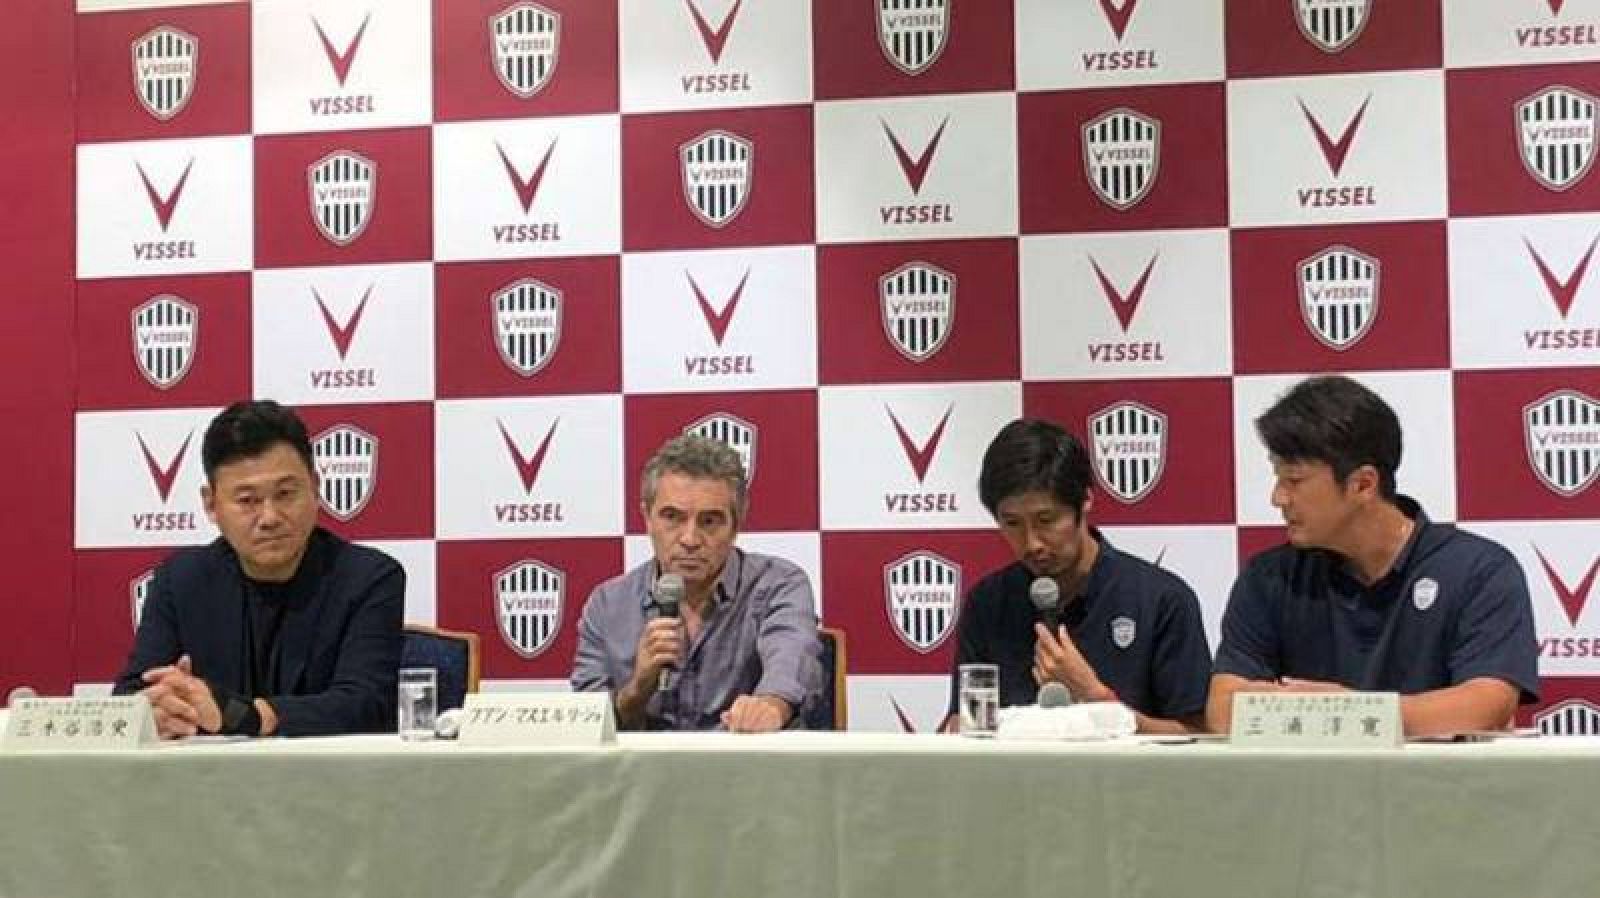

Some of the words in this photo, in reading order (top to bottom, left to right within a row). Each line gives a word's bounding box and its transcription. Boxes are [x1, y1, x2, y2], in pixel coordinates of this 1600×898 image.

[1516, 26, 1596, 46] VISSEL
[1082, 50, 1158, 70] VISSEL
[682, 74, 750, 92] VISSEL
[310, 96, 374, 114] VISSEL
[1298, 186, 1374, 206] VISSEL
[880, 204, 952, 224] VISSEL
[494, 224, 560, 242] VISSEL
[134, 240, 194, 260] VISSEL
[1088, 342, 1162, 362] VISSEL
[686, 356, 754, 374] VISSEL
[312, 370, 374, 388] VISSEL
[886, 494, 958, 512] VISSEL
[134, 512, 196, 530] VISSEL
[496, 504, 562, 522] VISSEL
